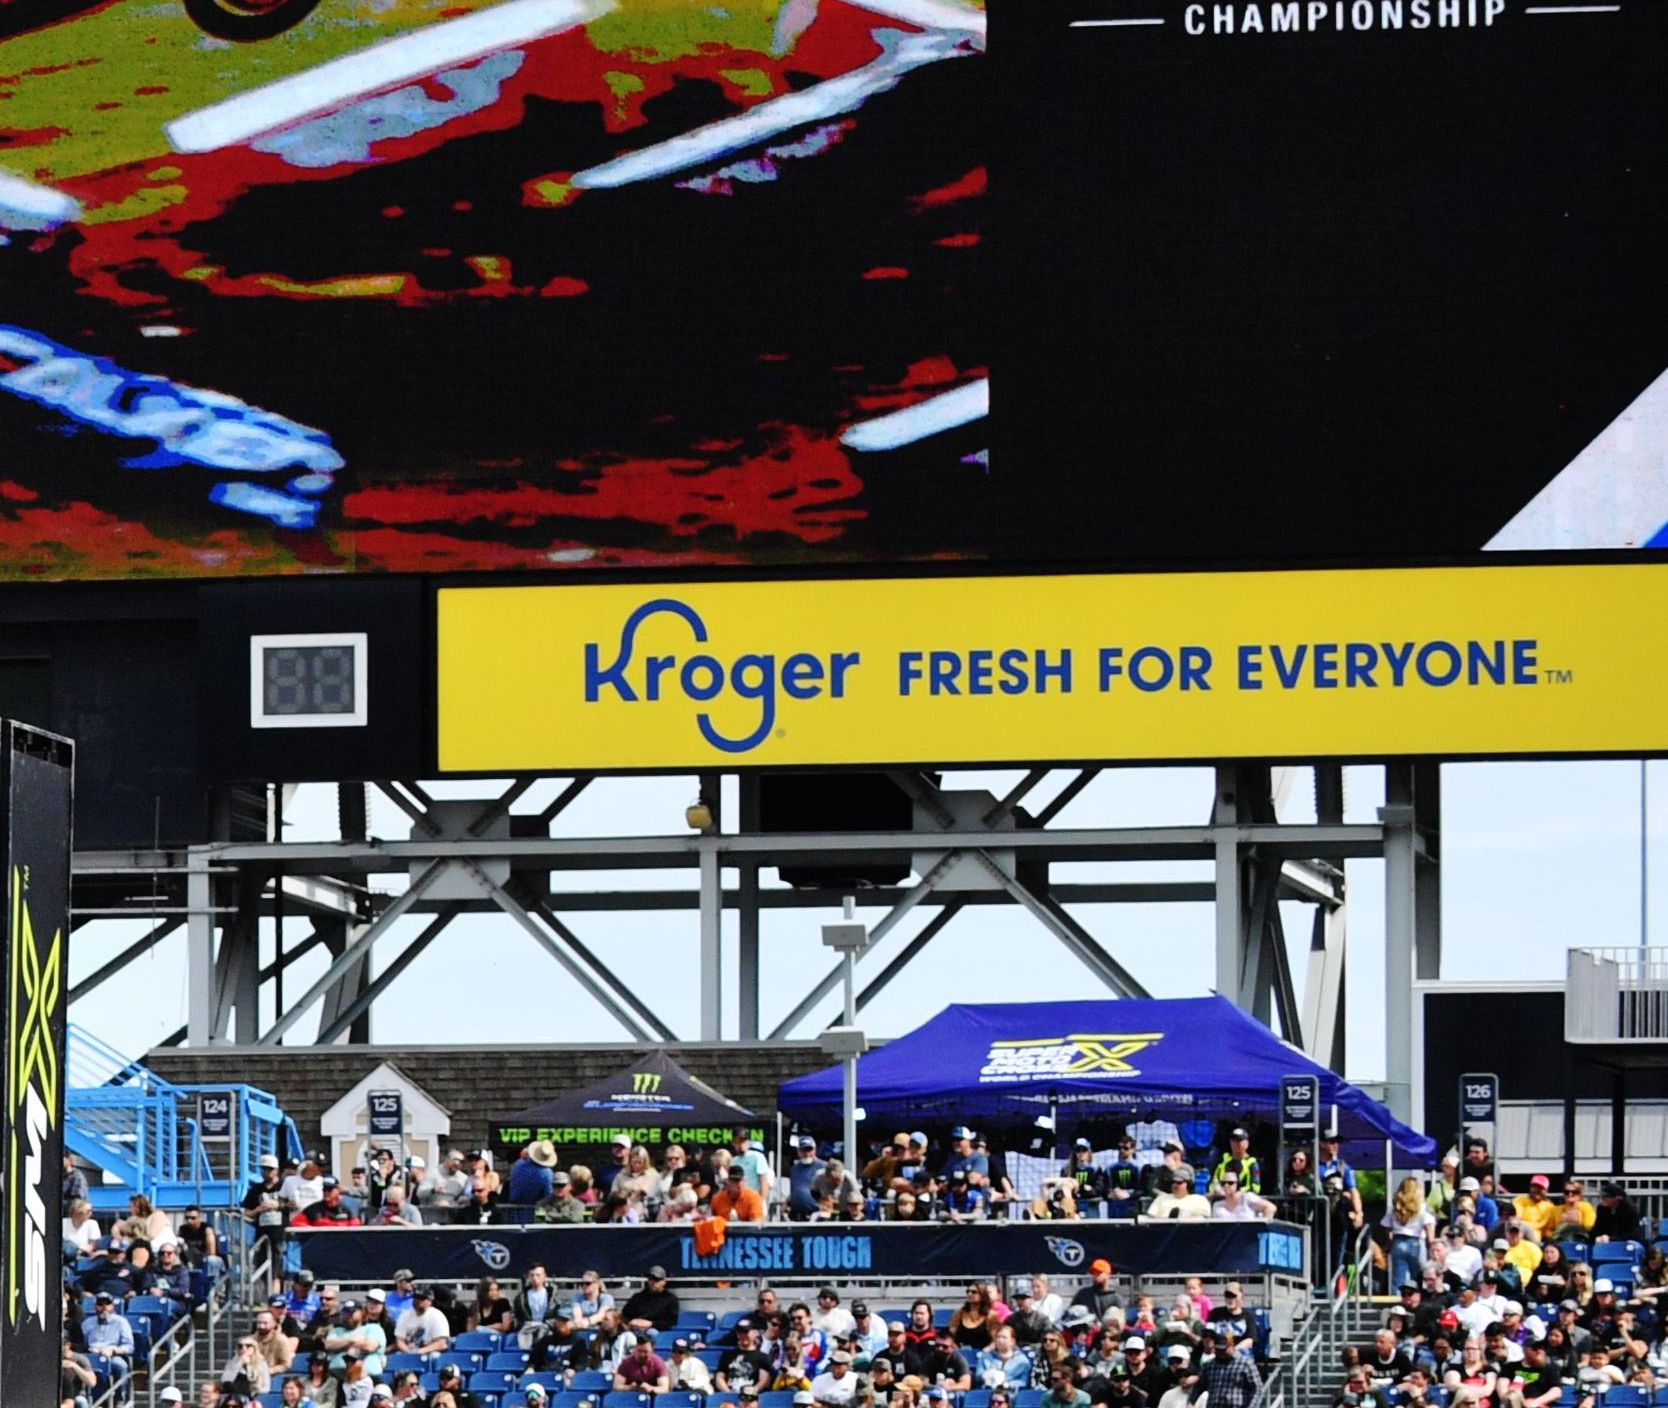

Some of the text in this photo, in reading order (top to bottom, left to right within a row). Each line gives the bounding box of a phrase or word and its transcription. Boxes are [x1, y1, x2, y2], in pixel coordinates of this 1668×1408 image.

[1184, 0, 1506, 34] CHAMPIONSHIP
[584, 597, 860, 753] Kroger
[898, 648, 1072, 696] FRESH
[1099, 645, 1212, 693] FOR
[1238, 639, 1538, 691] EVERYONE
[1286, 1086, 1312, 1101] 125
[1466, 1085, 1492, 1099] 126
[204, 1099, 227, 1114] 124
[373, 1098, 397, 1113] 125
[500, 1127, 733, 1145] VIP EXPERIENCE CHECK
[681, 1236, 872, 1270] TENESSEE TOUGH
